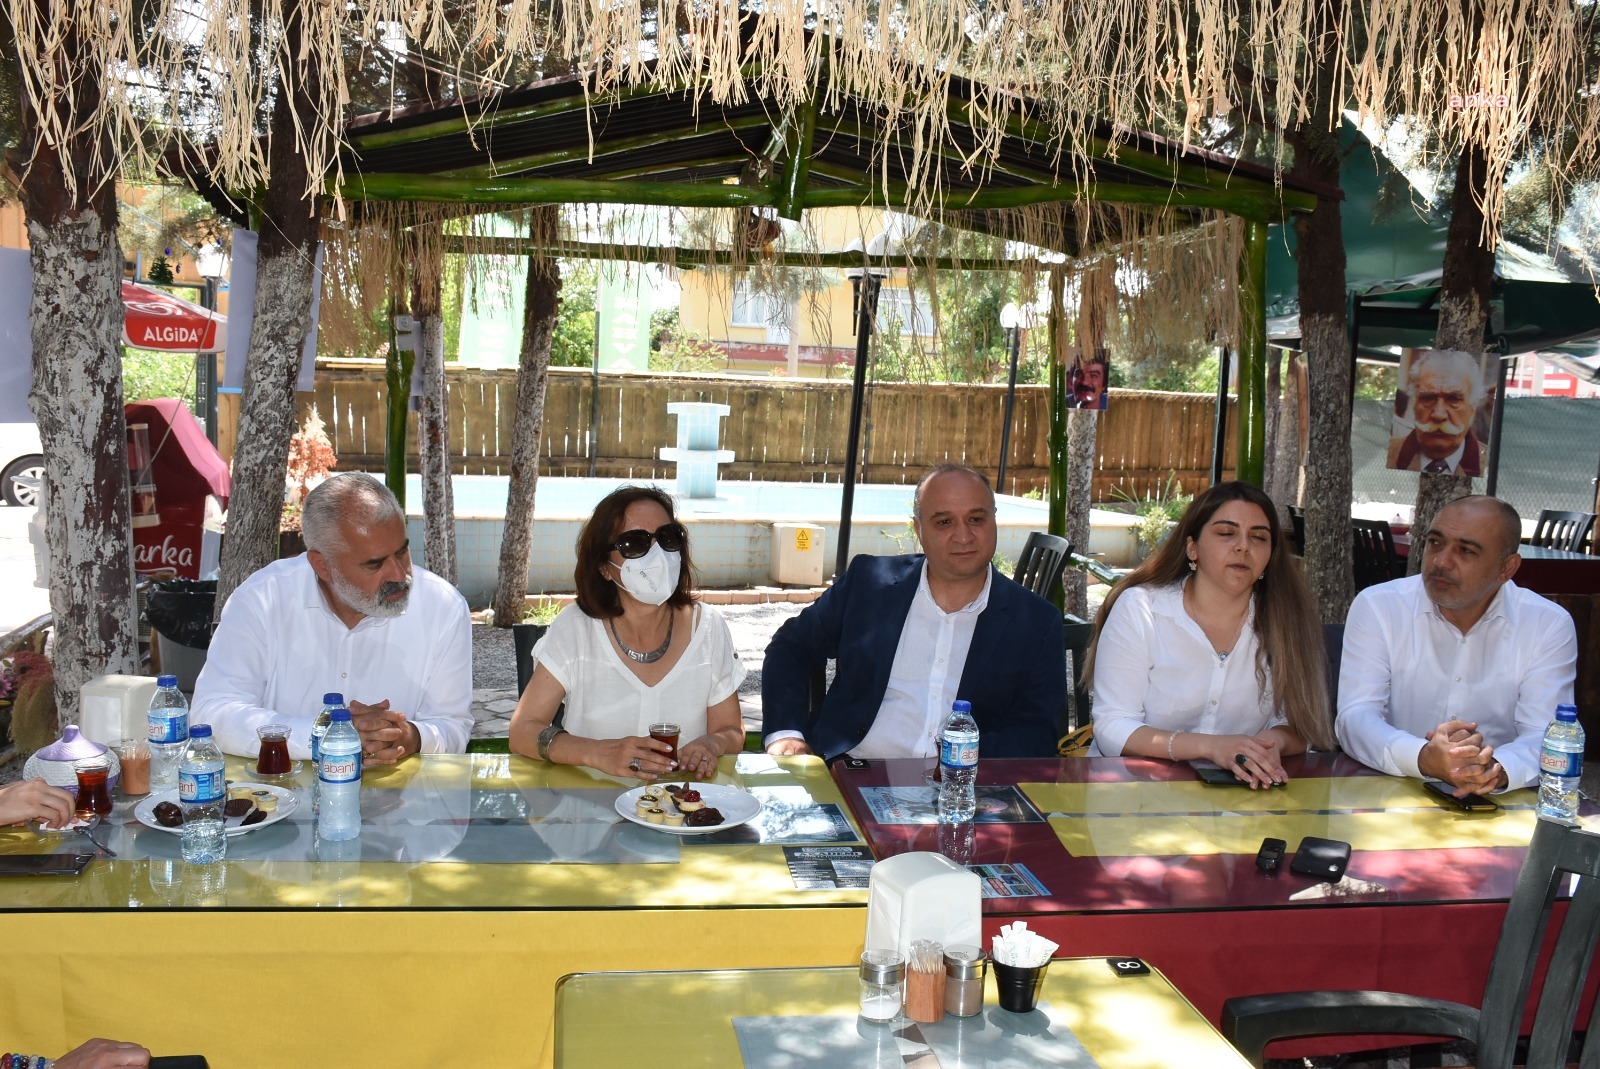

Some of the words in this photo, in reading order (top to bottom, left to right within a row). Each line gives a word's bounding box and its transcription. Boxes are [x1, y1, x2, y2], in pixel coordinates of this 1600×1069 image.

[134, 534, 193, 567] arka
[324, 761, 355, 774] abant
[179, 782, 194, 794] ant
[198, 774, 209, 800] BOLU
[1117, 961, 1141, 969] 8
